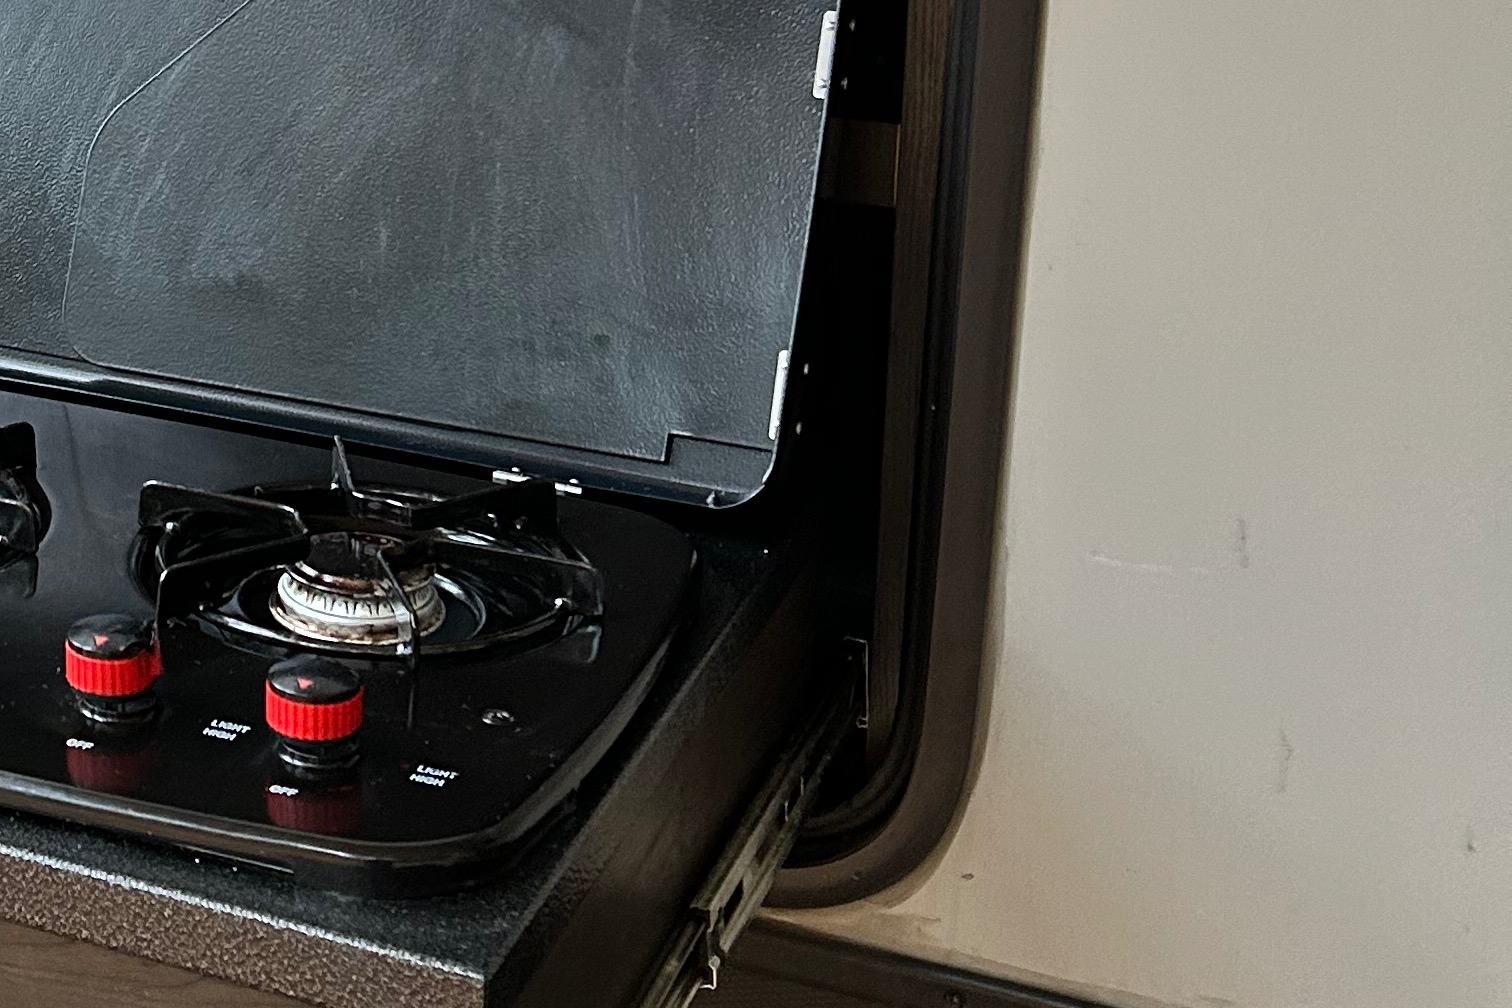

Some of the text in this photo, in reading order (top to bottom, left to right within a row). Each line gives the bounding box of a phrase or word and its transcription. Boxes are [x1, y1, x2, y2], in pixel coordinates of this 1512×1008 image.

[210, 719, 251, 734] LIGHT
[202, 727, 237, 741] HIGH
[65, 738, 94, 750] OFF
[417, 765, 459, 779] LIGHT
[409, 773, 445, 787] HIGH
[268, 784, 299, 796] OFF
